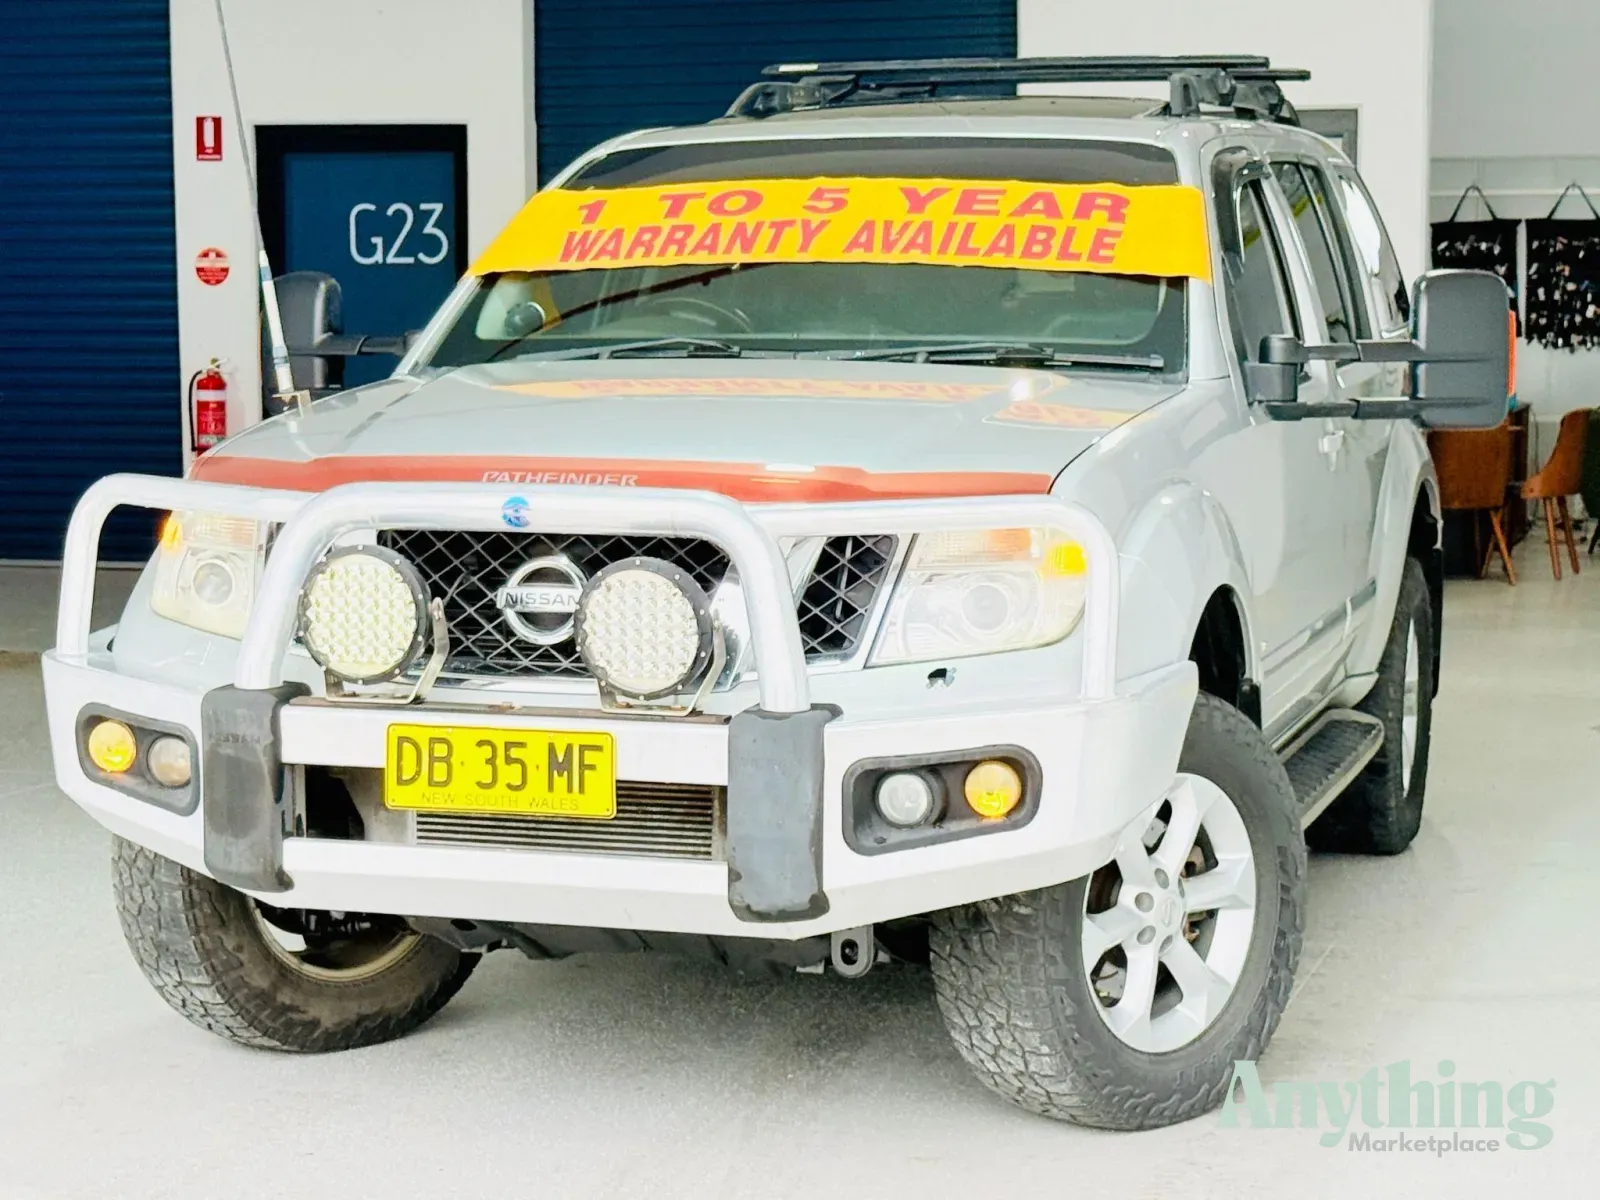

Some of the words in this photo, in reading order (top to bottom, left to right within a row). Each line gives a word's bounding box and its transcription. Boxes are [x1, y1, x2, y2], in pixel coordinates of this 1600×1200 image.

[577, 199, 608, 224] 1
[659, 188, 764, 220] TO
[802, 187, 849, 213] 5
[899, 187, 1131, 224] YEAR
[349, 202, 449, 265] G23
[559, 219, 831, 263] WARRANTY
[842, 219, 1125, 264] AVAILABLE
[482, 471, 639, 487] PATHFINDER
[505, 591, 578, 606] NISSAN
[396, 736, 454, 787] DB
[475, 739, 529, 792] 35
[547, 742, 604, 795] MF
[421, 791, 458, 805] NEW
[465, 793, 519, 808] SOUTH
[528, 796, 580, 811] WALES
